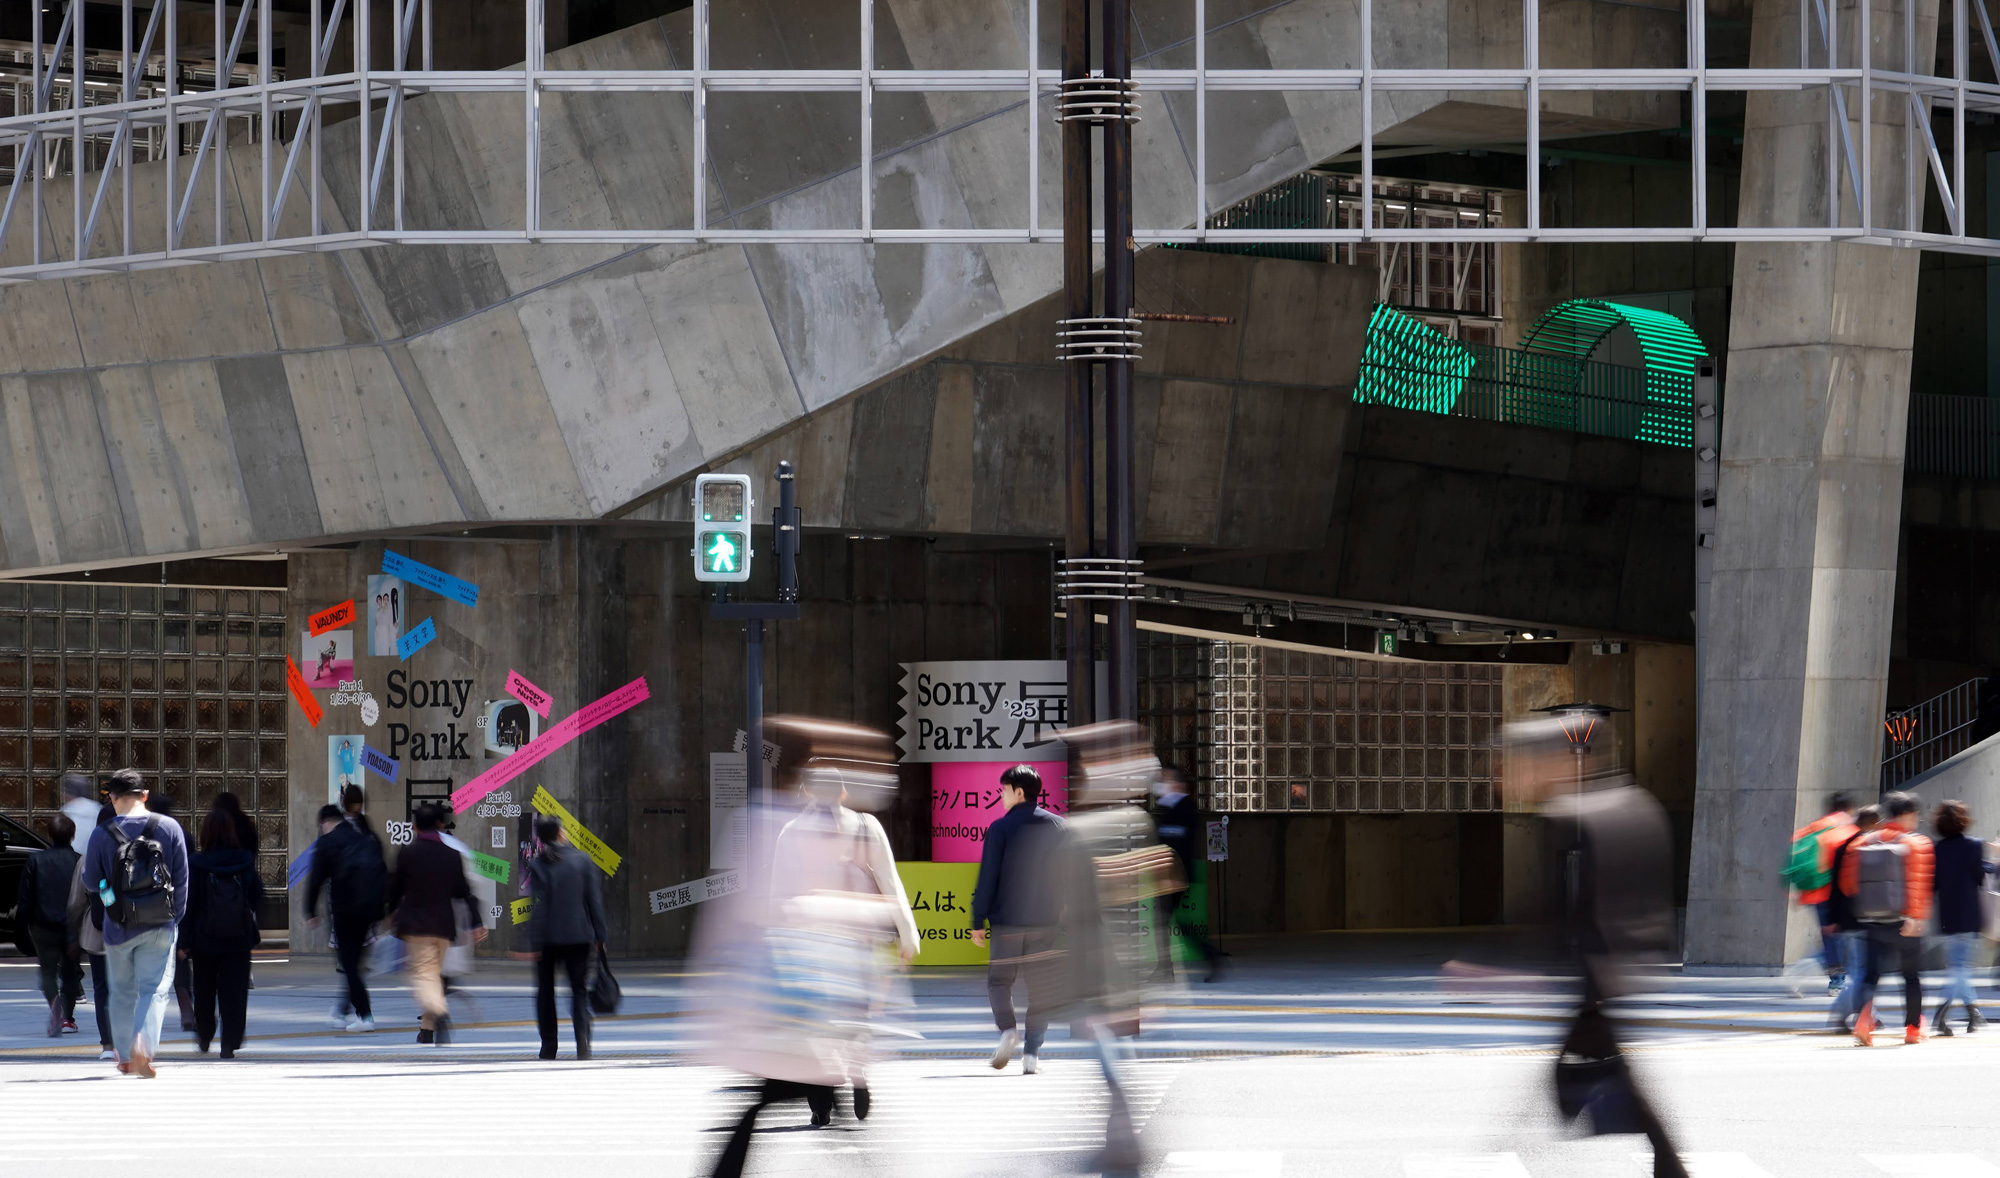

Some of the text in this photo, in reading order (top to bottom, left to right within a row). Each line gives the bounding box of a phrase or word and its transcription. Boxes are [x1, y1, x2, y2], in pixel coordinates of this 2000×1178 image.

[315, 607, 348, 629] VAUNDY
[404, 626, 428, 651] 羊文学
[340, 681, 362, 690] Part 1
[387, 670, 474, 718] Sony
[513, 678, 545, 704] Creepy
[918, 673, 1006, 715] Sony
[516, 687, 538, 707] Nuts
[477, 717, 488, 727] 3F
[387, 723, 470, 761] Park
[918, 718, 1003, 750] Park
[367, 751, 393, 776] YOASOBI
[486, 792, 511, 802] Part 2
[477, 805, 520, 817] 4/20-6/22
[705, 876, 726, 888] Sony
[707, 886, 727, 897] Park
[656, 889, 677, 900] Sony
[658, 886, 692, 910] Park 展
[490, 907, 502, 916] 4F
